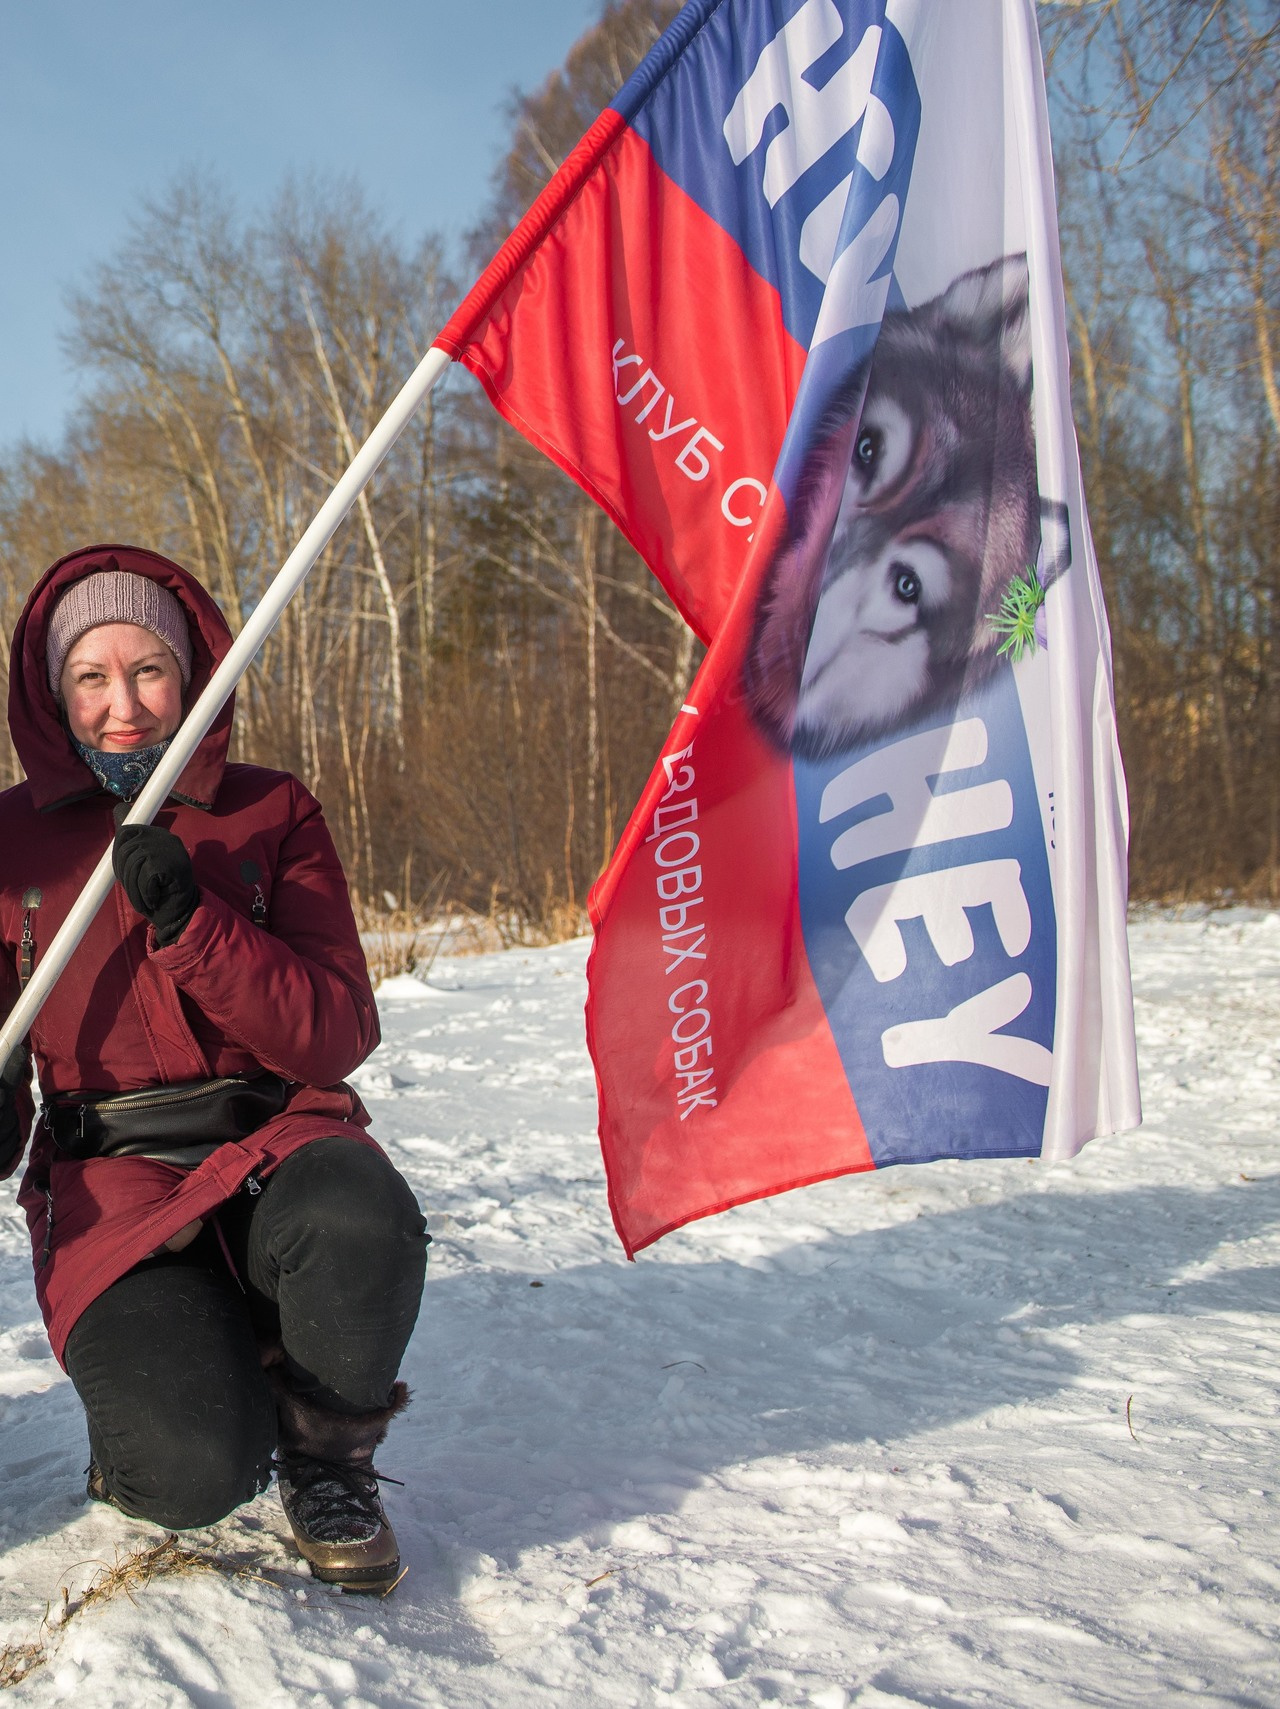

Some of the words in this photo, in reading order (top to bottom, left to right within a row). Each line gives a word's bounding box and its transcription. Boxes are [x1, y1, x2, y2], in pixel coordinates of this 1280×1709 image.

[612, 337, 725, 482] КЛУБ
[819, 717, 1054, 1087] HEY
[667, 979, 718, 1121] СОБАК
